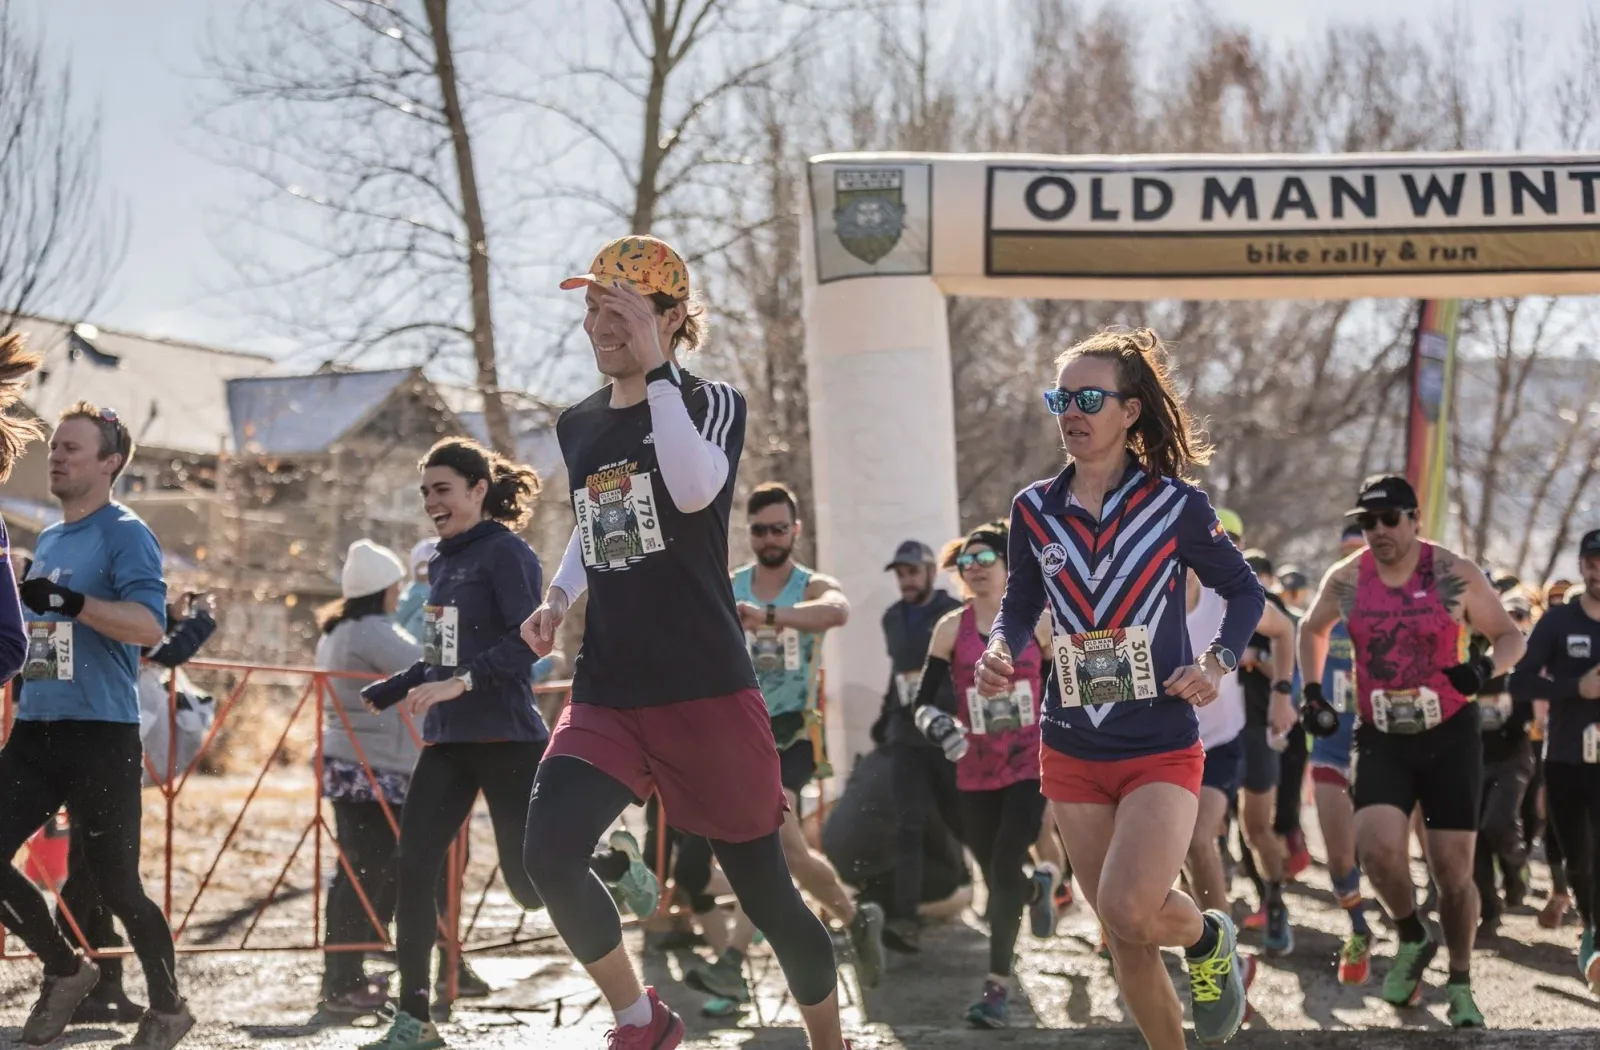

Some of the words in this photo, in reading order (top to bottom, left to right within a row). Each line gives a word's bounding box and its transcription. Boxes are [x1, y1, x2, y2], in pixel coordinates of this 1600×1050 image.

[1024, 175, 1174, 221] OLD
[1201, 173, 1377, 221] MAN
[1400, 170, 1600, 218] WINT
[1246, 243, 1310, 265] bike
[1320, 241, 1386, 268] rally
[1398, 240, 1417, 260] &
[1429, 245, 1477, 261] run
[586, 461, 638, 485] BROOKLYN
[577, 499, 588, 523] 10K
[637, 495, 656, 530] 779
[582, 526, 592, 555] RUN
[445, 624, 455, 649] 774
[59, 639, 70, 663] 775
[1131, 640, 1151, 681] 3071
[1058, 646, 1074, 696] COMBO
